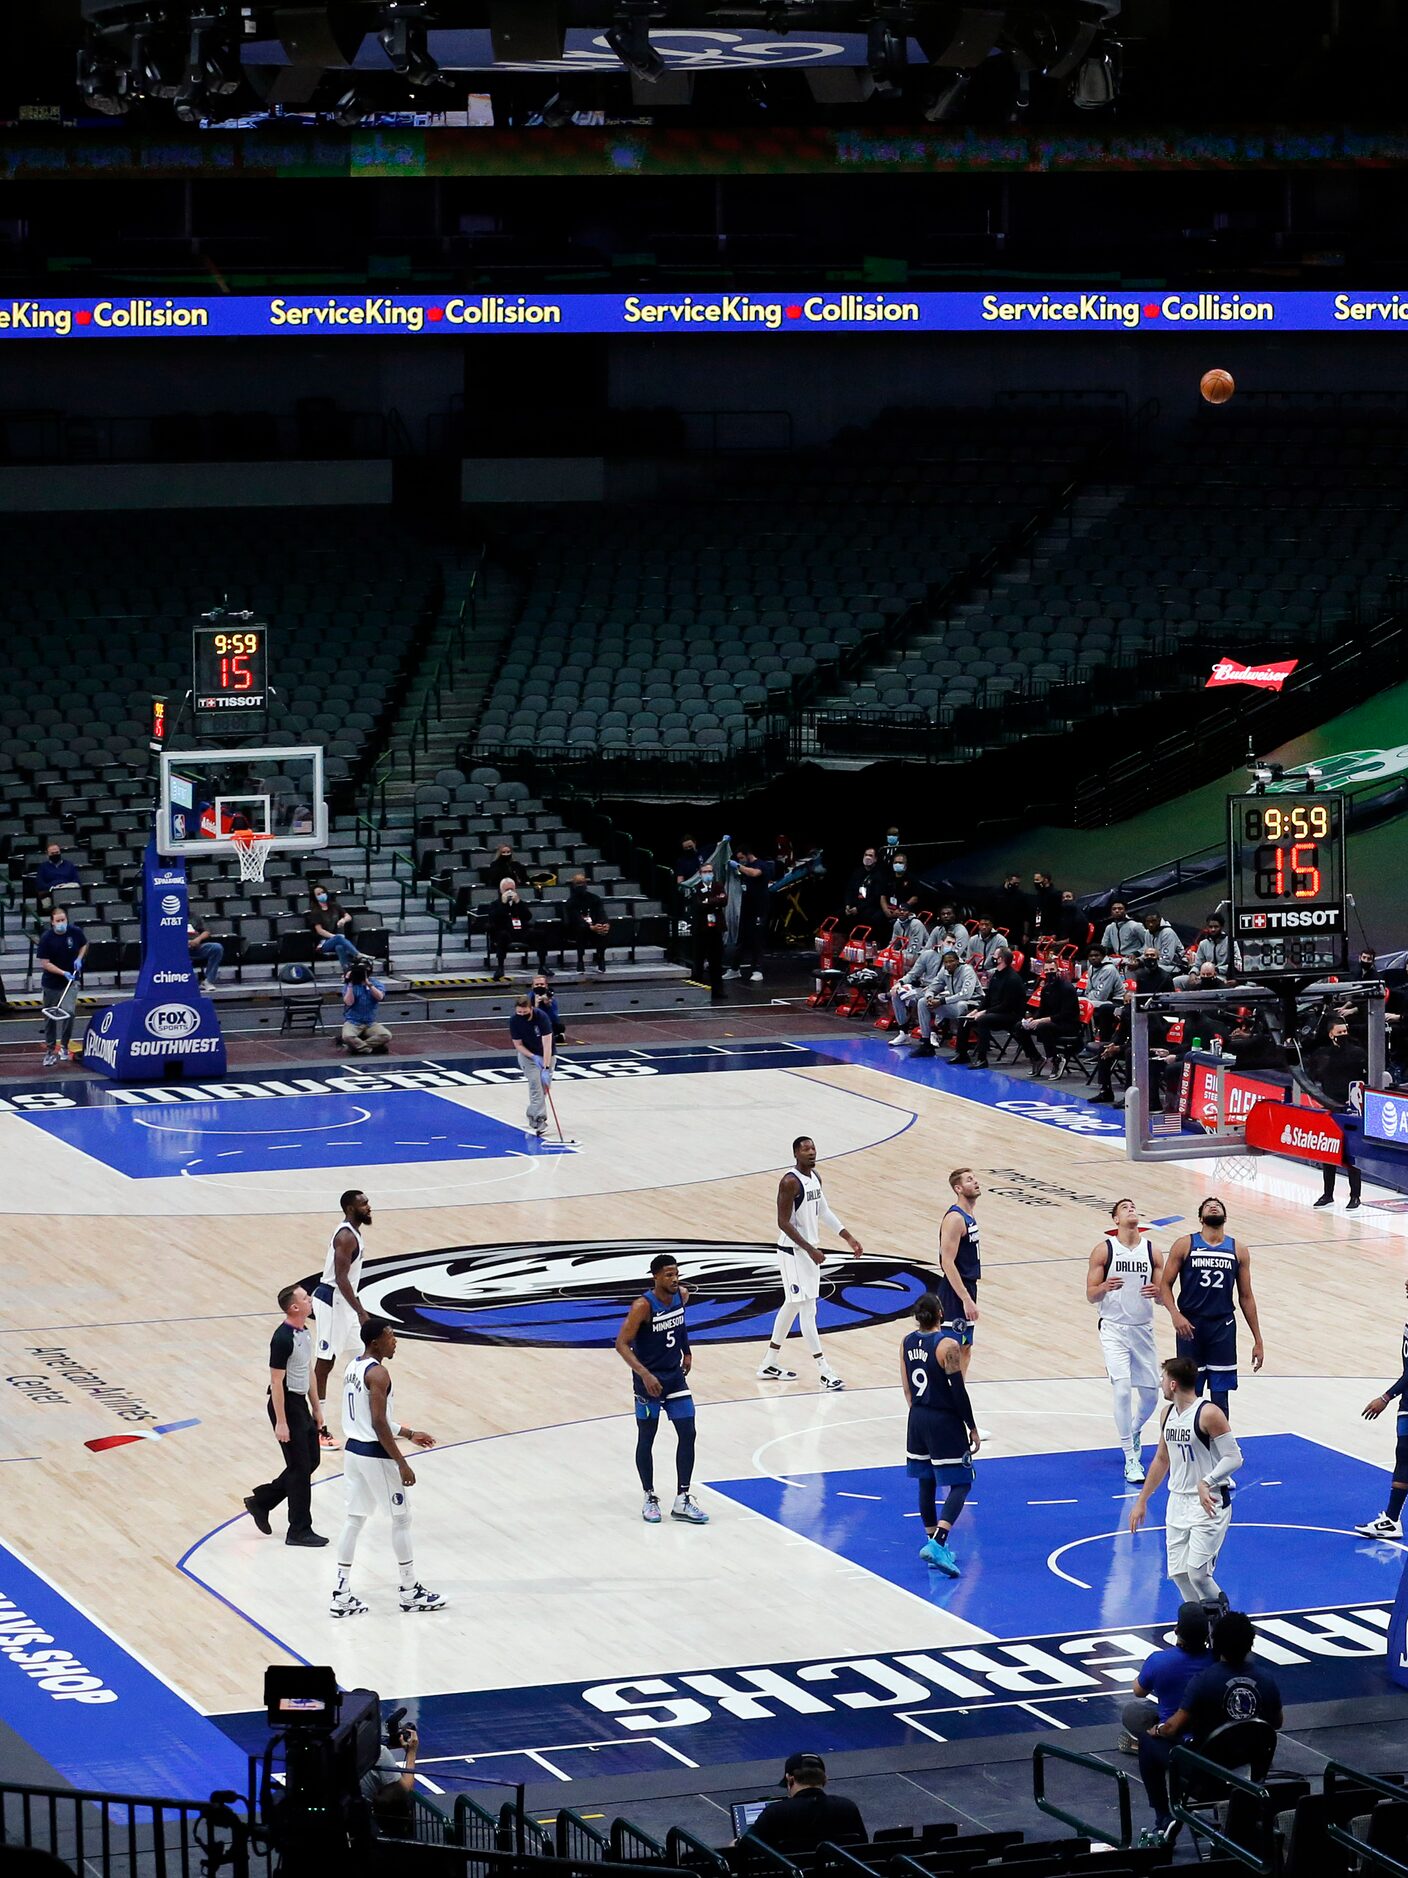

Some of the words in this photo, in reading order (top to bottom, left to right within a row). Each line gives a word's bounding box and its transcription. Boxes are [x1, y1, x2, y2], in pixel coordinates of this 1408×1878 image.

[93, 300, 208, 327] Collision
[271, 299, 423, 330] ServiceKing
[446, 298, 560, 323] Collision
[624, 297, 781, 328] ServiceKing
[804, 296, 918, 320] Collision
[982, 295, 1139, 327] ServiceKing
[1162, 295, 1272, 320] Collision
[214, 634, 257, 655] 9:59
[221, 655, 253, 689] 15
[1211, 664, 1290, 682] Budweiser
[216, 696, 264, 708] TISSOT
[1264, 806, 1328, 840] 9:59
[1275, 842, 1321, 898] 15
[154, 876, 186, 886] SPALDING
[160, 917, 184, 927] AT&T
[1267, 910, 1340, 928] TISSOT
[153, 971, 191, 984] chime
[158, 1012, 188, 1025] FOX
[158, 1024, 189, 1032] SPORTS
[84, 1028, 119, 1069] SPALDING
[130, 1038, 220, 1057] SOUTHWEST
[1115, 1260, 1148, 1273] DALLAS
[1191, 1257, 1232, 1270] MINNESOTA
[1199, 1269, 1224, 1289] 32
[665, 1330, 677, 1349] 5
[5, 1375, 72, 1405] Center
[24, 1347, 108, 1392] American
[87, 1387, 158, 1422] Airlines
[911, 1368, 929, 1397] 9
[348, 1392, 356, 1422] 0
[1165, 1428, 1191, 1442] DALLAS
[1177, 1443, 1195, 1463] 77
